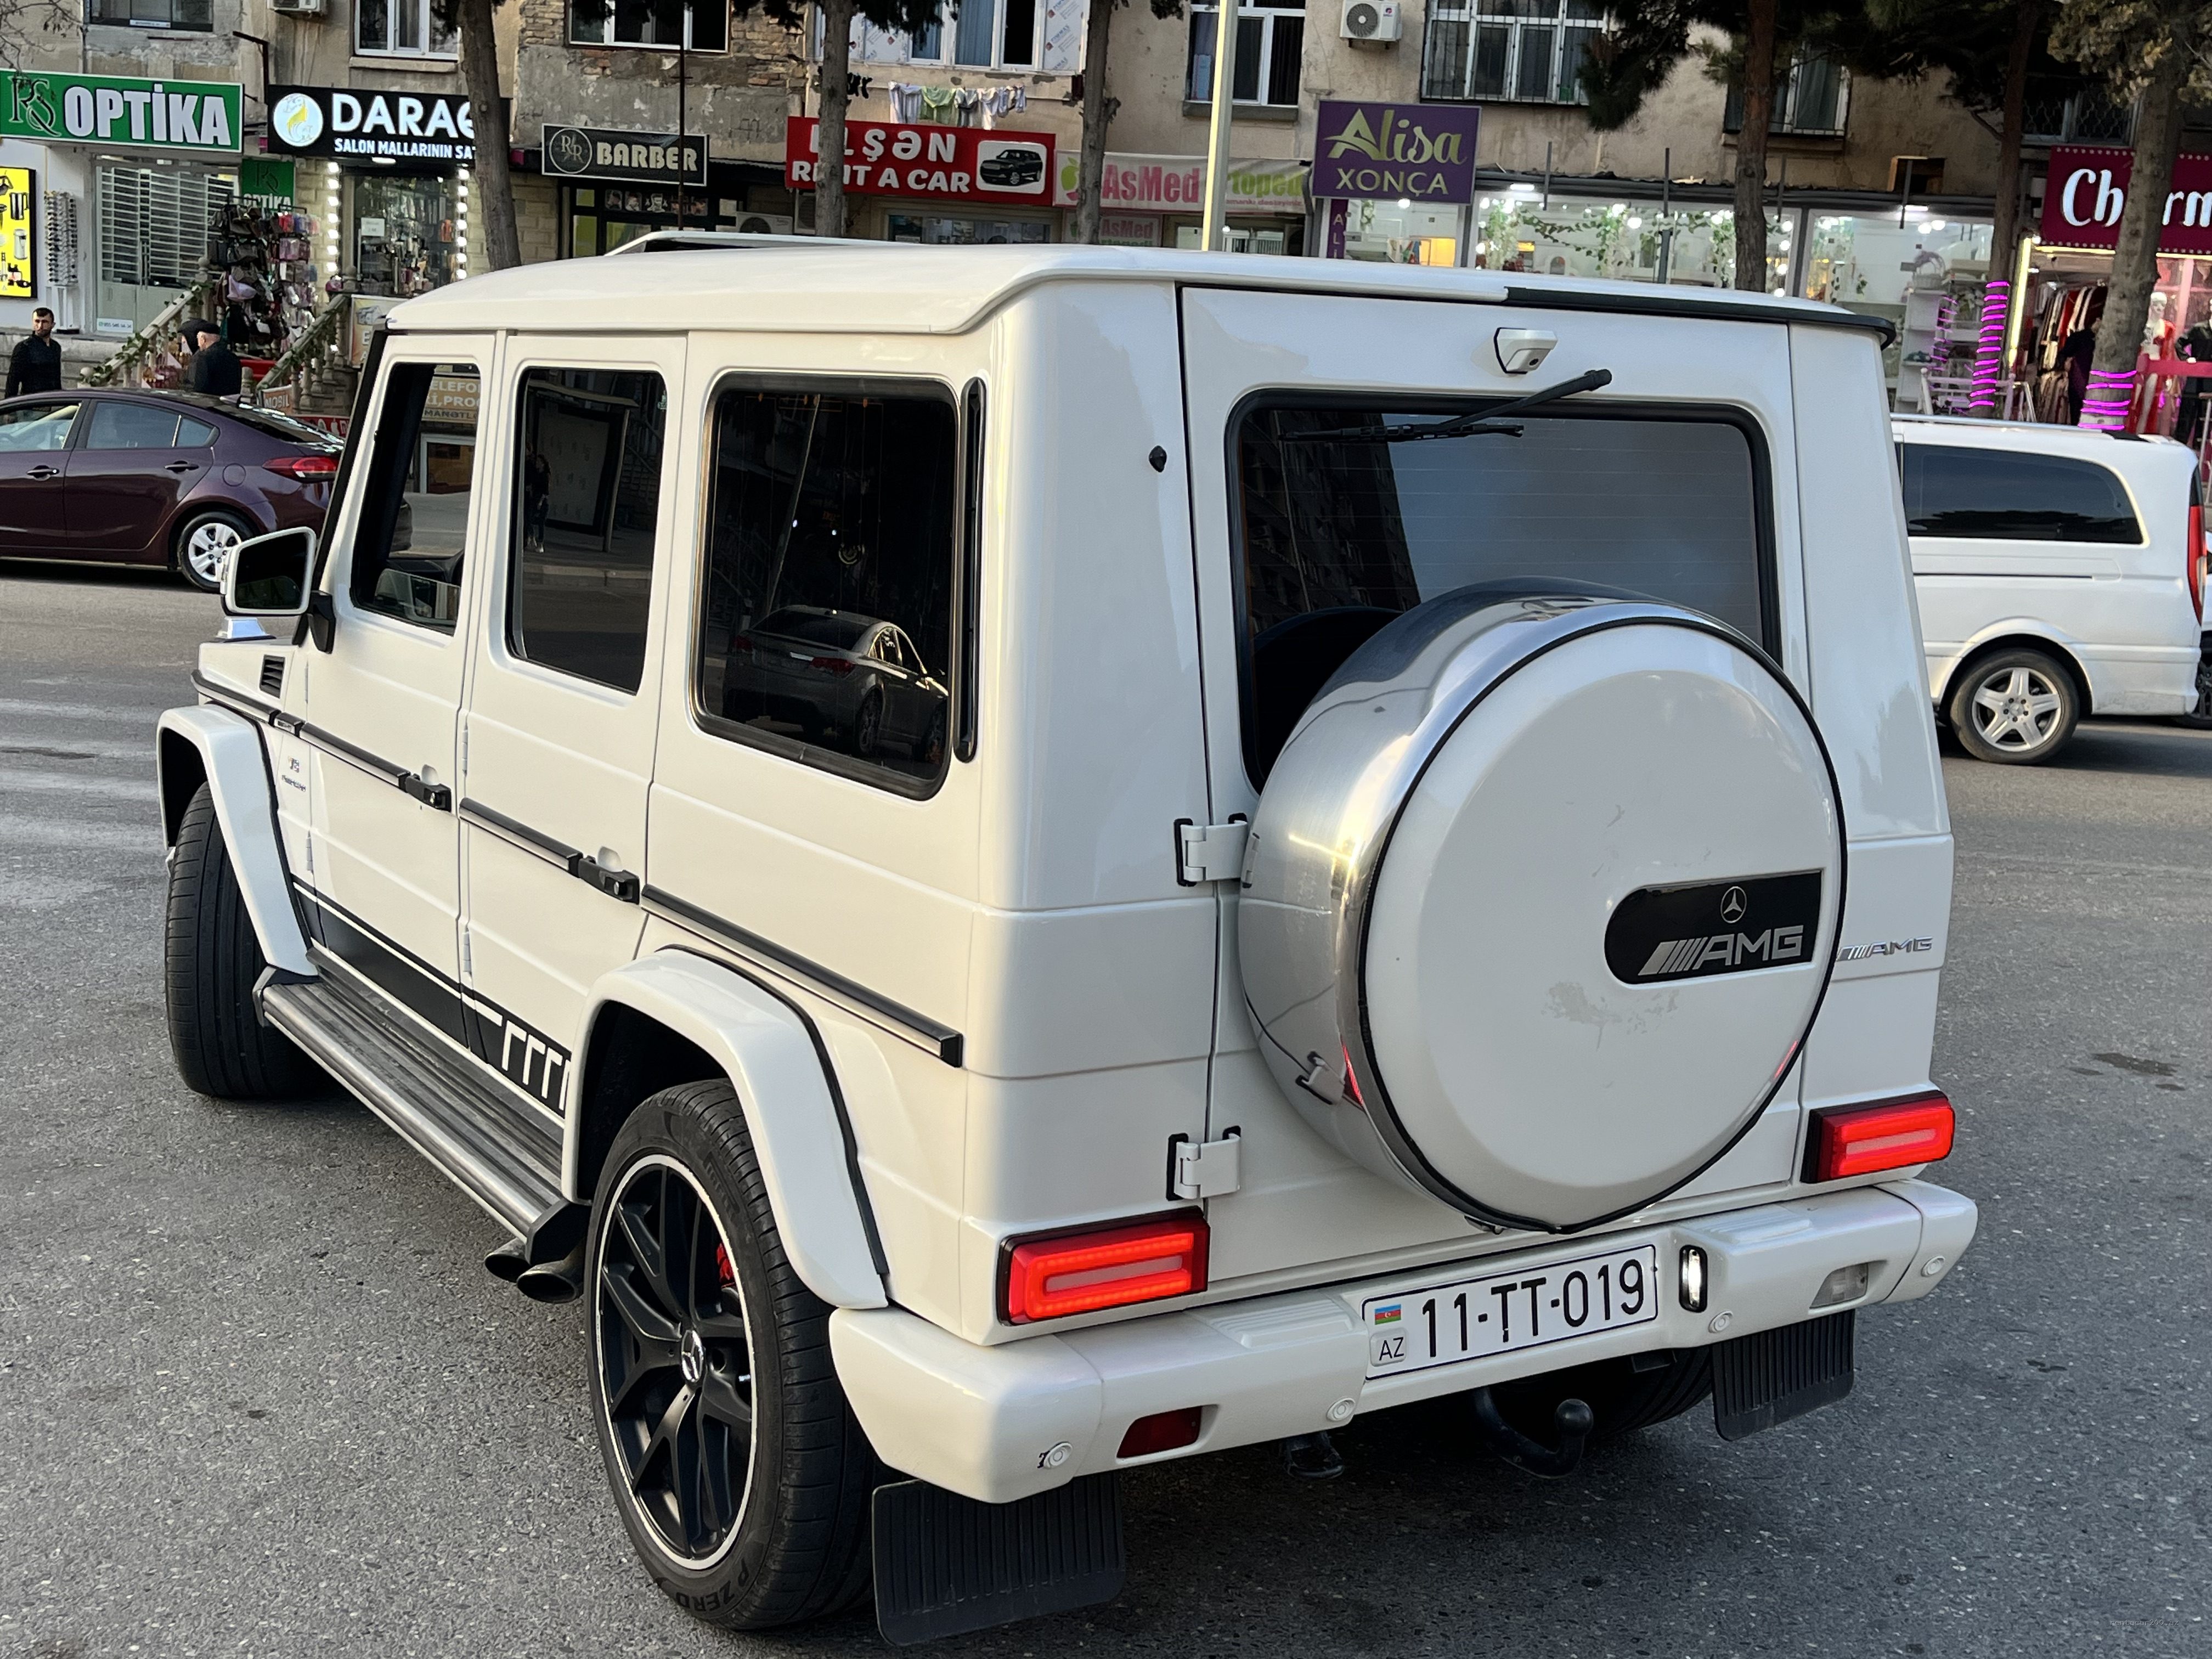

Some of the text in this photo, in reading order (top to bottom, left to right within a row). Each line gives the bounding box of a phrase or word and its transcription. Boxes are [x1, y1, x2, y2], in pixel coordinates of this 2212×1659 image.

[64, 83, 232, 146] OPTİKA
[334, 138, 476, 159] SALON MALLARININ SA
[1323, 108, 1468, 165] Alisa
[596, 142, 697, 171] BARBER
[877, 168, 900, 189] A
[907, 169, 970, 193] CAR
[1101, 165, 1200, 203] AsMed
[1335, 168, 1449, 197] XONÇA
[243, 193, 292, 211] OPTİKA
[2062, 168, 2212, 228] Chrm
[1101, 219, 1154, 238] AsMed
[1422, 1259, 1644, 1358] 11-TT-019
[1379, 1337, 1404, 1361] AZ
